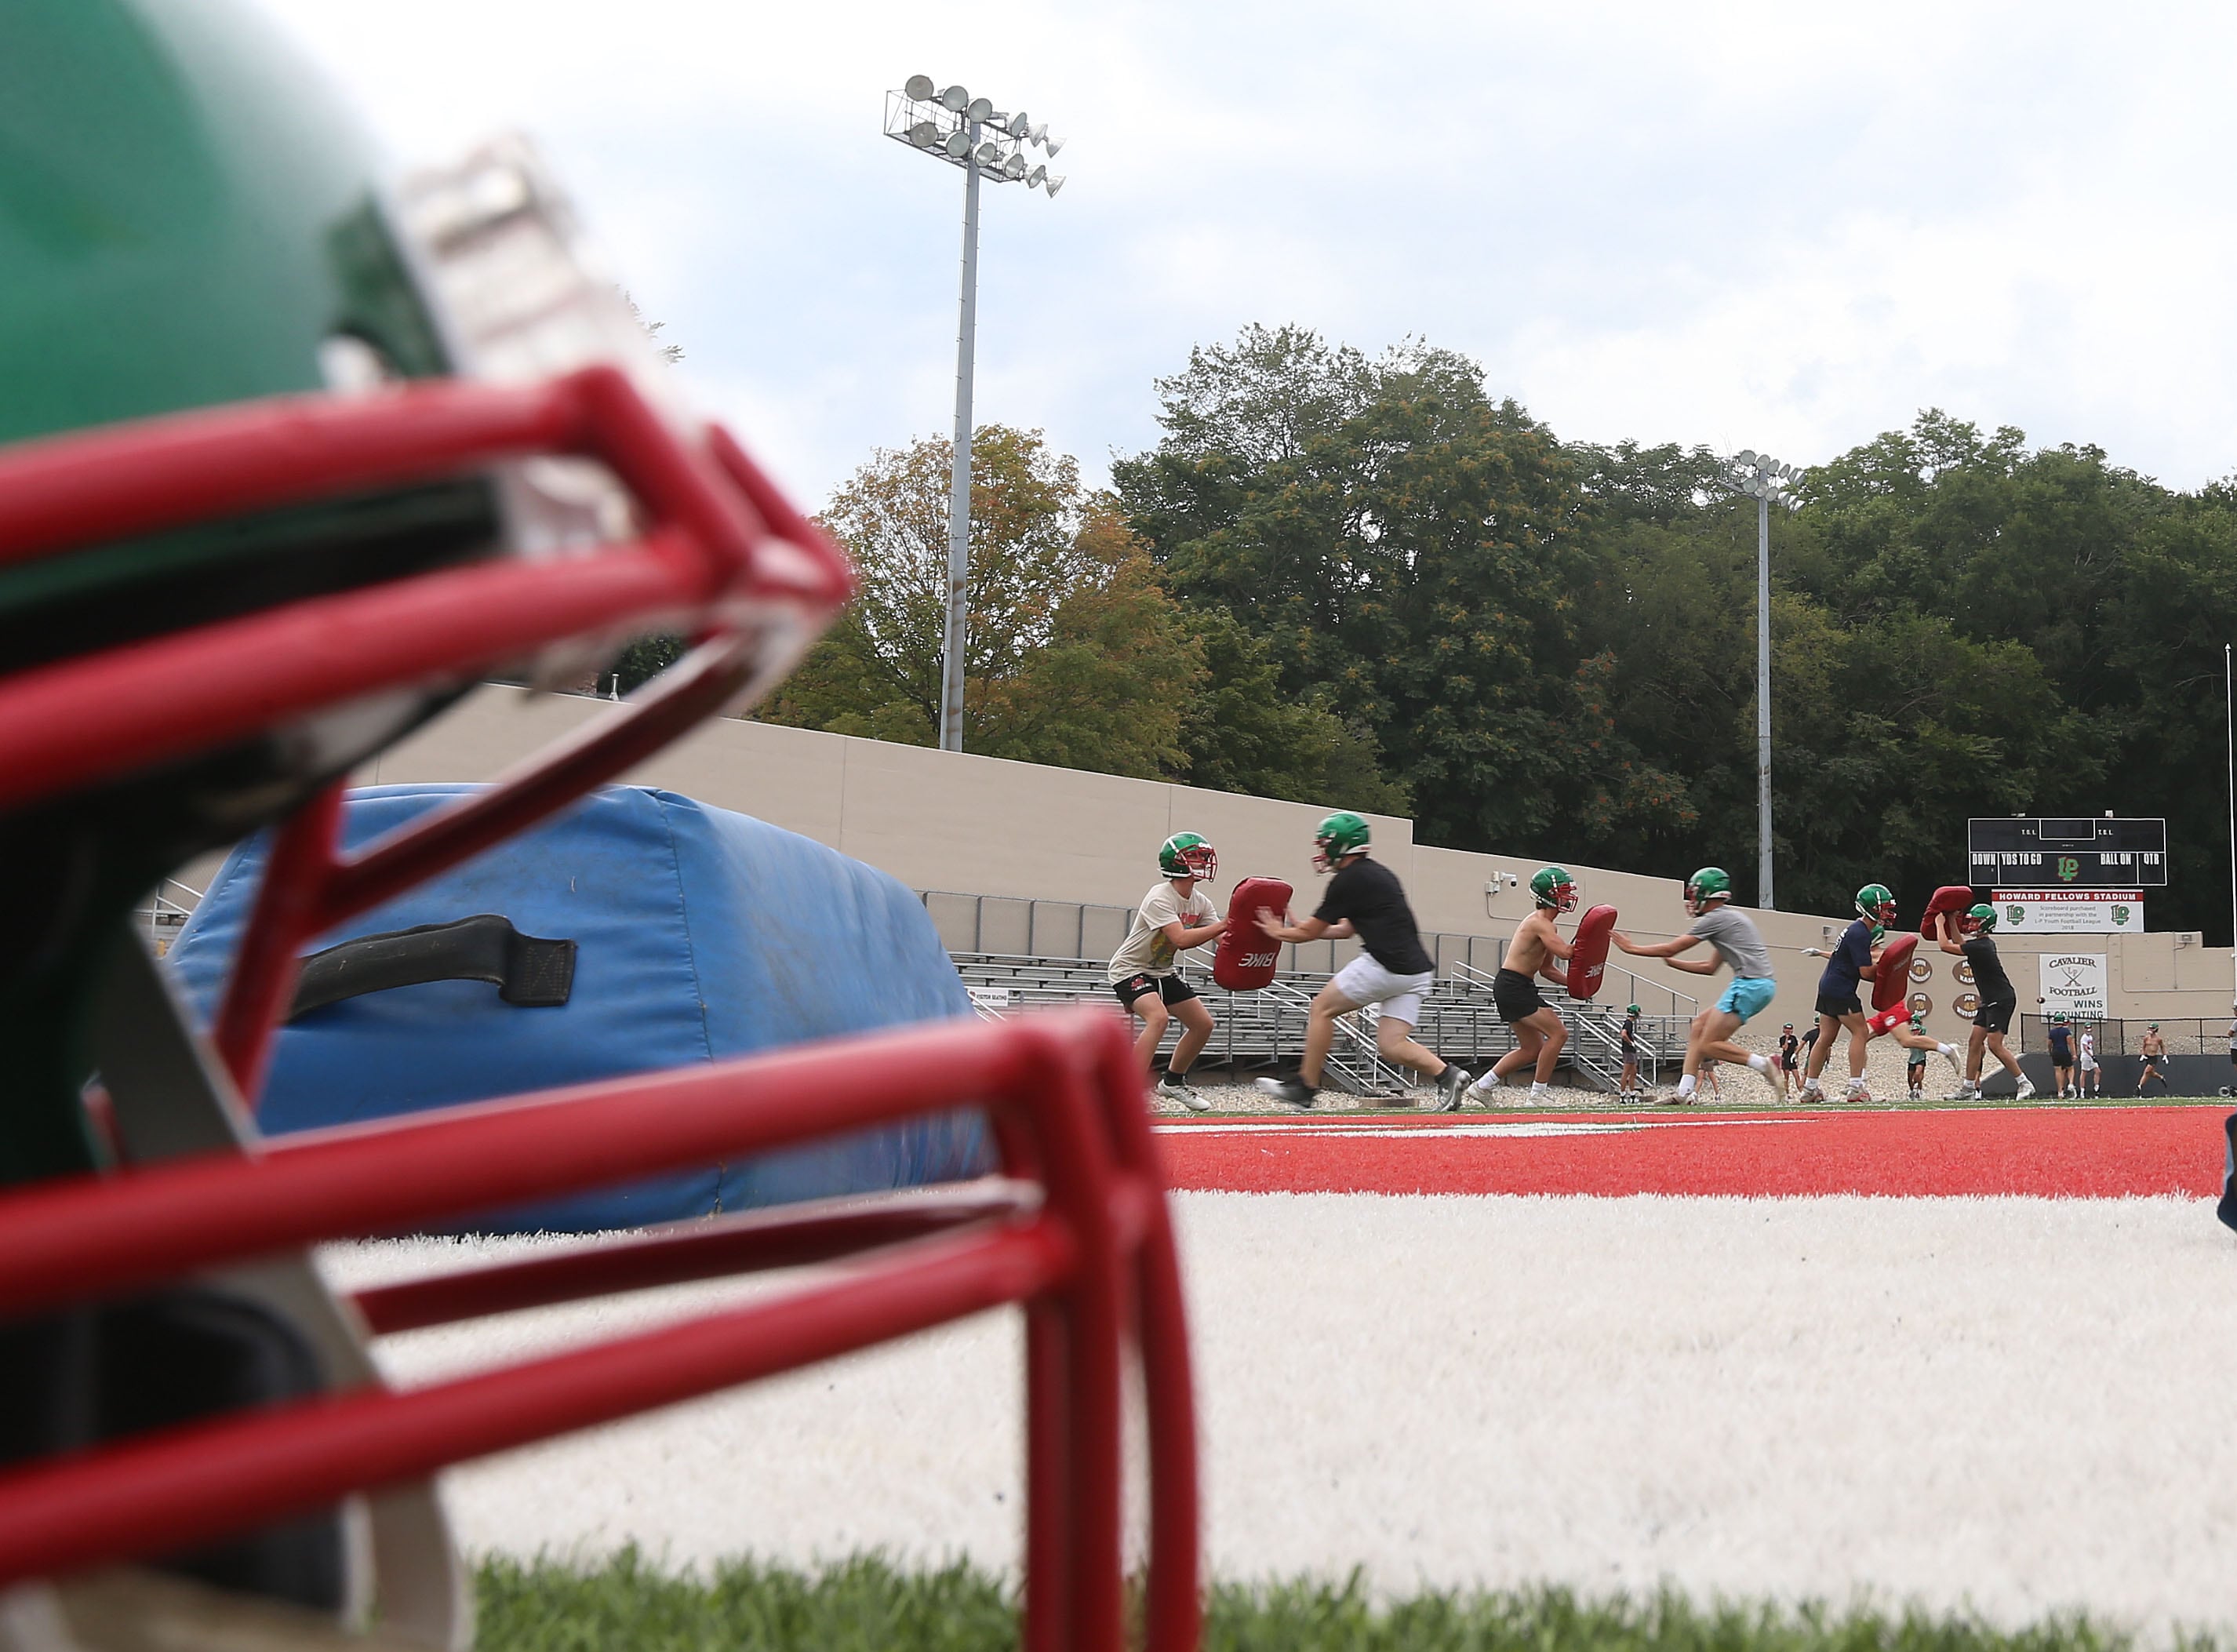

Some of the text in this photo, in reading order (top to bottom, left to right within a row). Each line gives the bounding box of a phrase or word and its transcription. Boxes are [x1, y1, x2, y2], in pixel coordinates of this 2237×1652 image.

[1972, 853, 1996, 865] DOWN
[2001, 853, 2042, 865] YDS TO GO
[2100, 853, 2132, 865] BALL ON
[2143, 853, 2159, 865] QTR
[1238, 952, 1275, 966] BIKE
[2049, 957, 2097, 968] CAVALIER
[2049, 986, 2098, 996] FOOTBALL
[2073, 999, 2103, 1008] WINS
[2054, 1010, 2104, 1019] COUNTING
